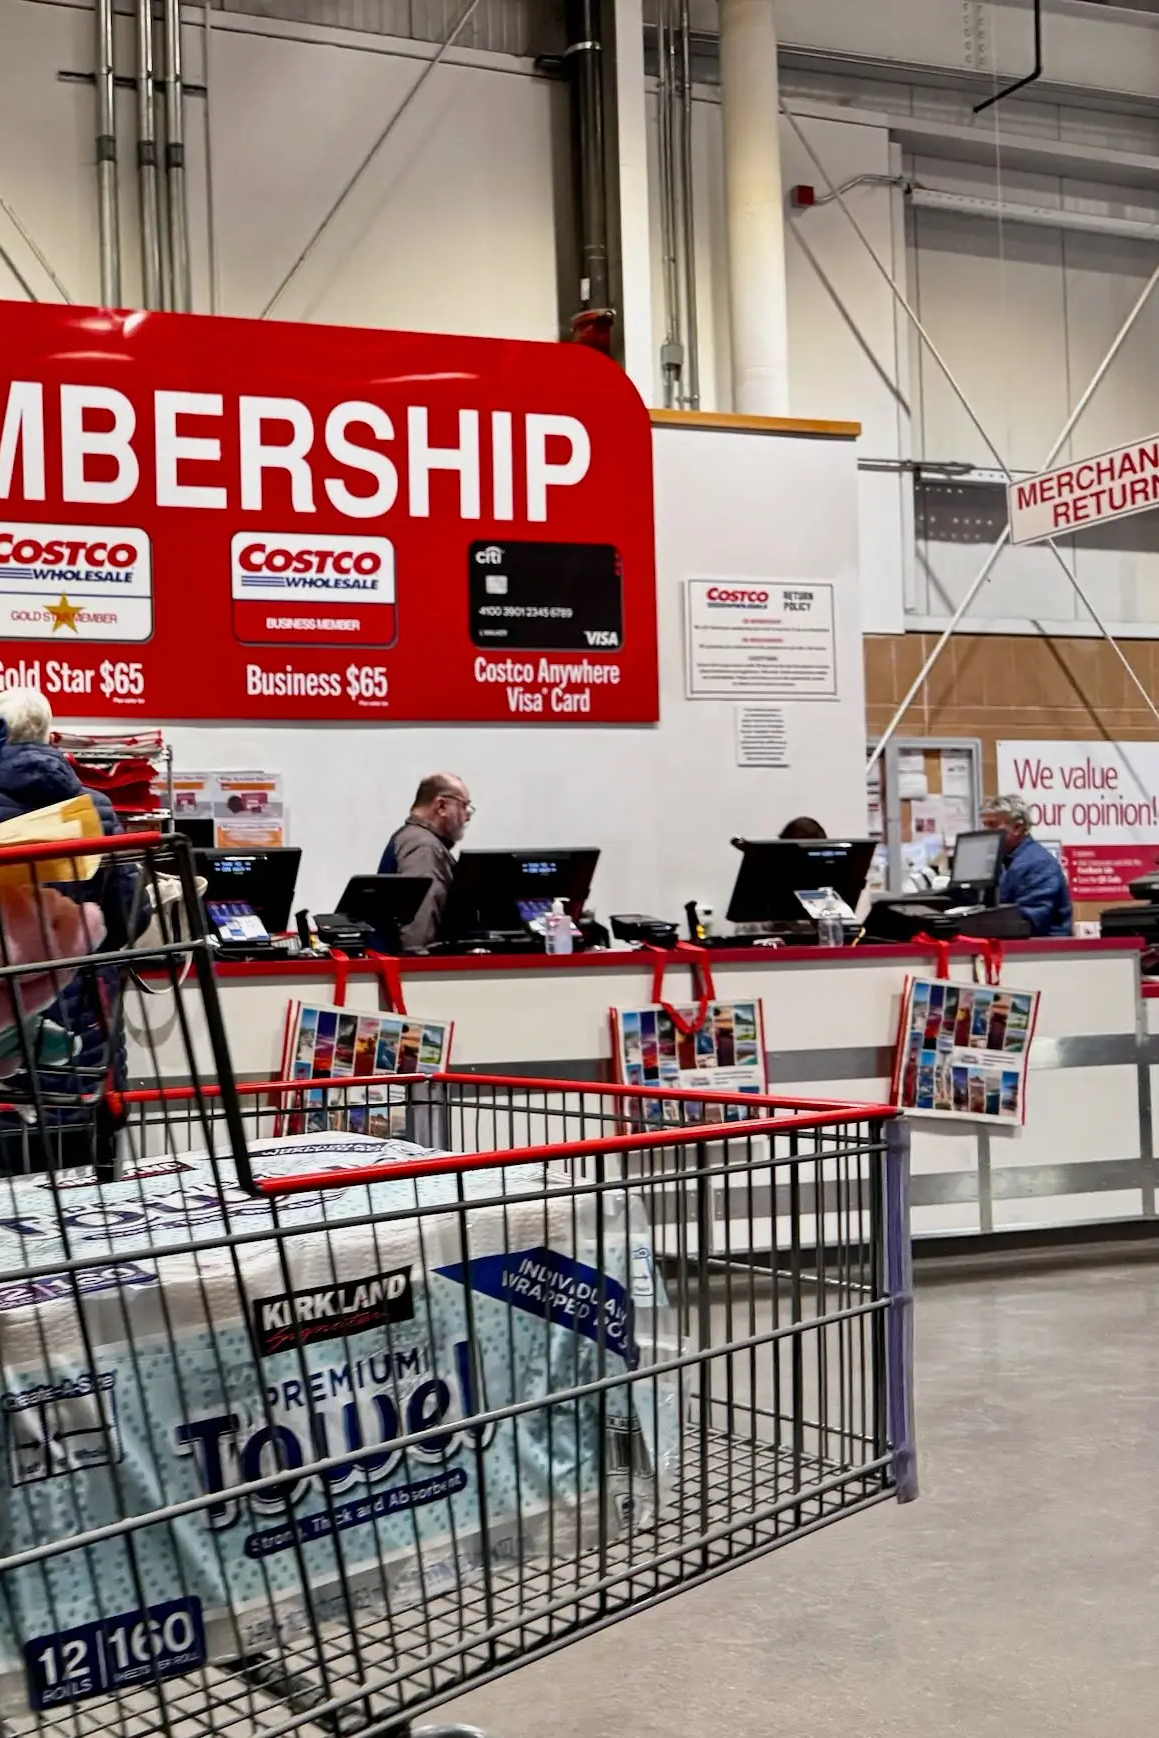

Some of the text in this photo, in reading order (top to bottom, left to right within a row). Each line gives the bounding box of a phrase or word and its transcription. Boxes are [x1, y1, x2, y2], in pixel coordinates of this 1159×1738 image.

[238, 543, 382, 576] COSTCO
[474, 546, 503, 564] citi
[32, 568, 134, 584] WHOLESALE
[284, 576, 379, 590] WHOLESALE
[706, 587, 769, 603] COSTCO
[10, 609, 42, 621] GOLD
[266, 617, 360, 631] BUSINESS MEMBER
[584, 631, 619, 646] VISA
[45, 660, 95, 693] Star
[99, 659, 145, 698] $65
[246, 663, 389, 701] Business $65
[474, 656, 621, 689] Costco Anywhere
[550, 687, 591, 713] Card
[1013, 756, 1119, 790] We value
[1028, 795, 1159, 836] our opinion!
[262, 1273, 407, 1332] KIRKLAND
[176, 1339, 489, 1527] Towel
[108, 1611, 195, 1669] 160
[38, 1639, 91, 1687] 12
